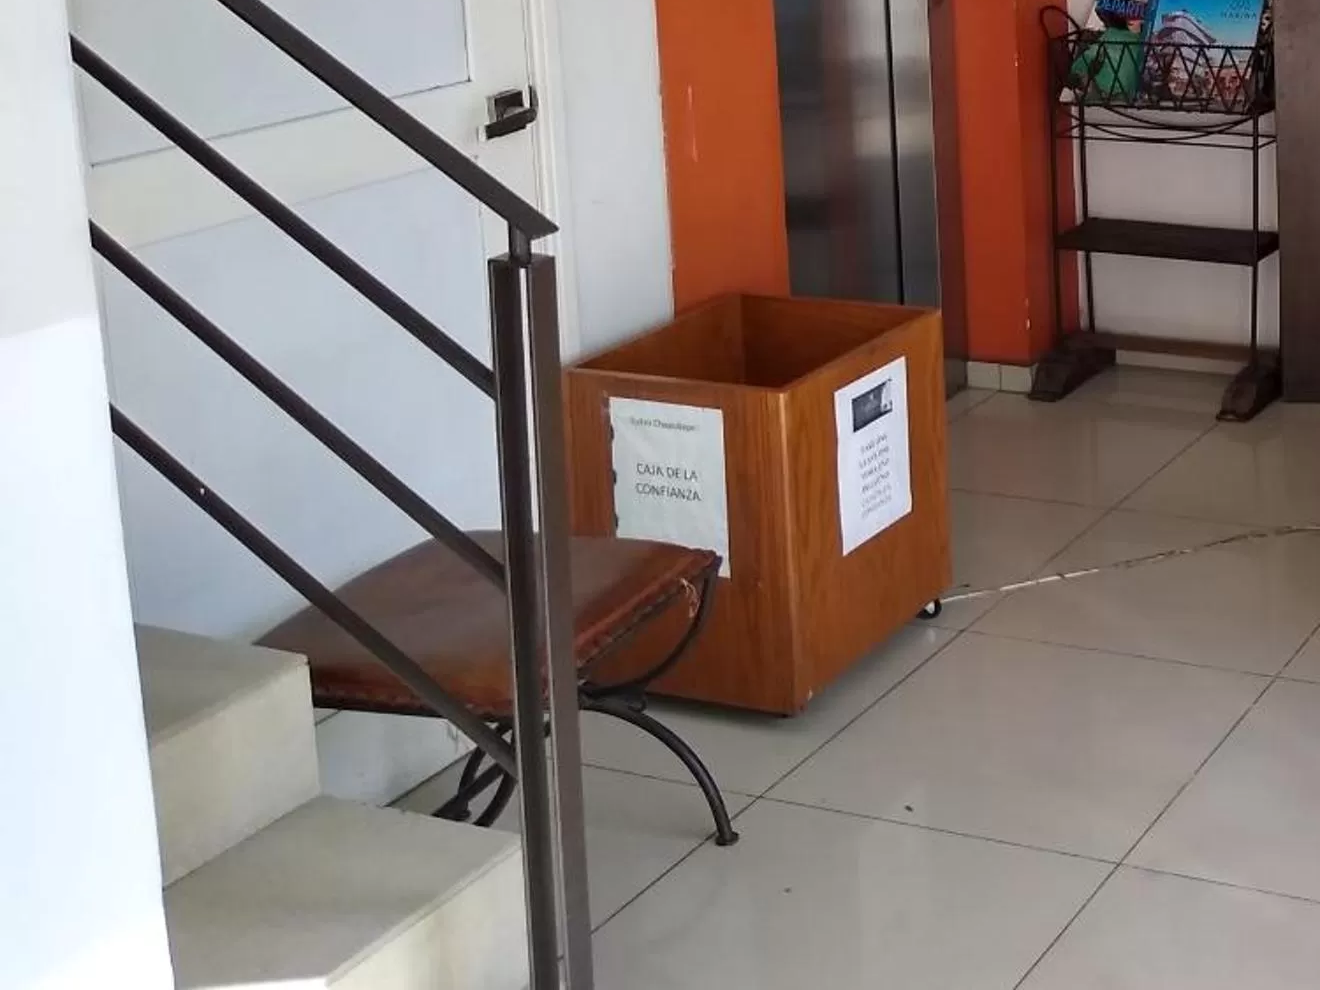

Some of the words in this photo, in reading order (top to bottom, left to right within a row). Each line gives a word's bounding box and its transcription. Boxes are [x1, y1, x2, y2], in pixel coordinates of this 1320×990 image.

[636, 462, 664, 477] CAJA
[666, 466, 681, 479] DE
[683, 469, 698, 482] LA
[635, 482, 702, 502] CONFIANZA
